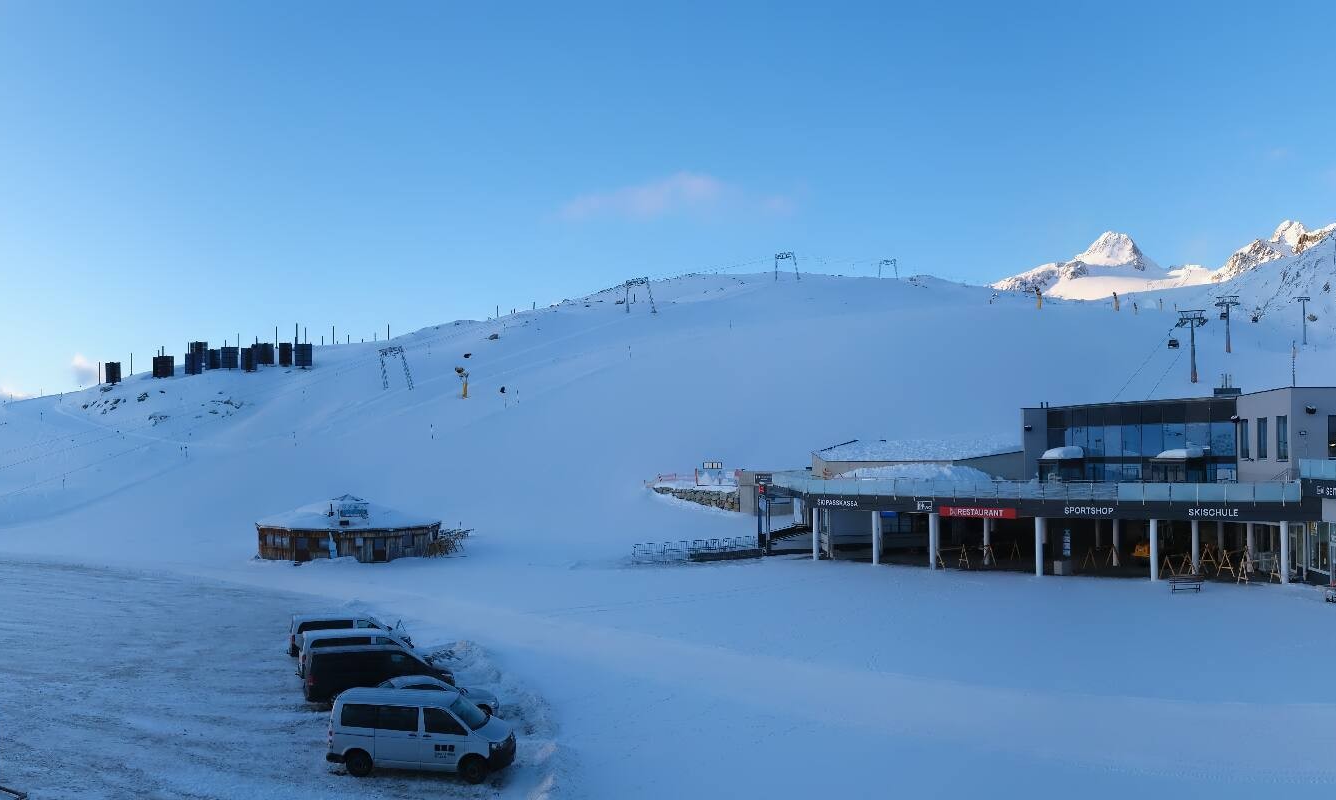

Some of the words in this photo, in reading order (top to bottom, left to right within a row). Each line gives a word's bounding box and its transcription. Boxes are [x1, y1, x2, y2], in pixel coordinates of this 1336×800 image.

[957, 508, 1004, 517] RESTAURANT
[1064, 506, 1114, 515] SPORTSHOP
[1188, 508, 1239, 517] SKISCHULE
